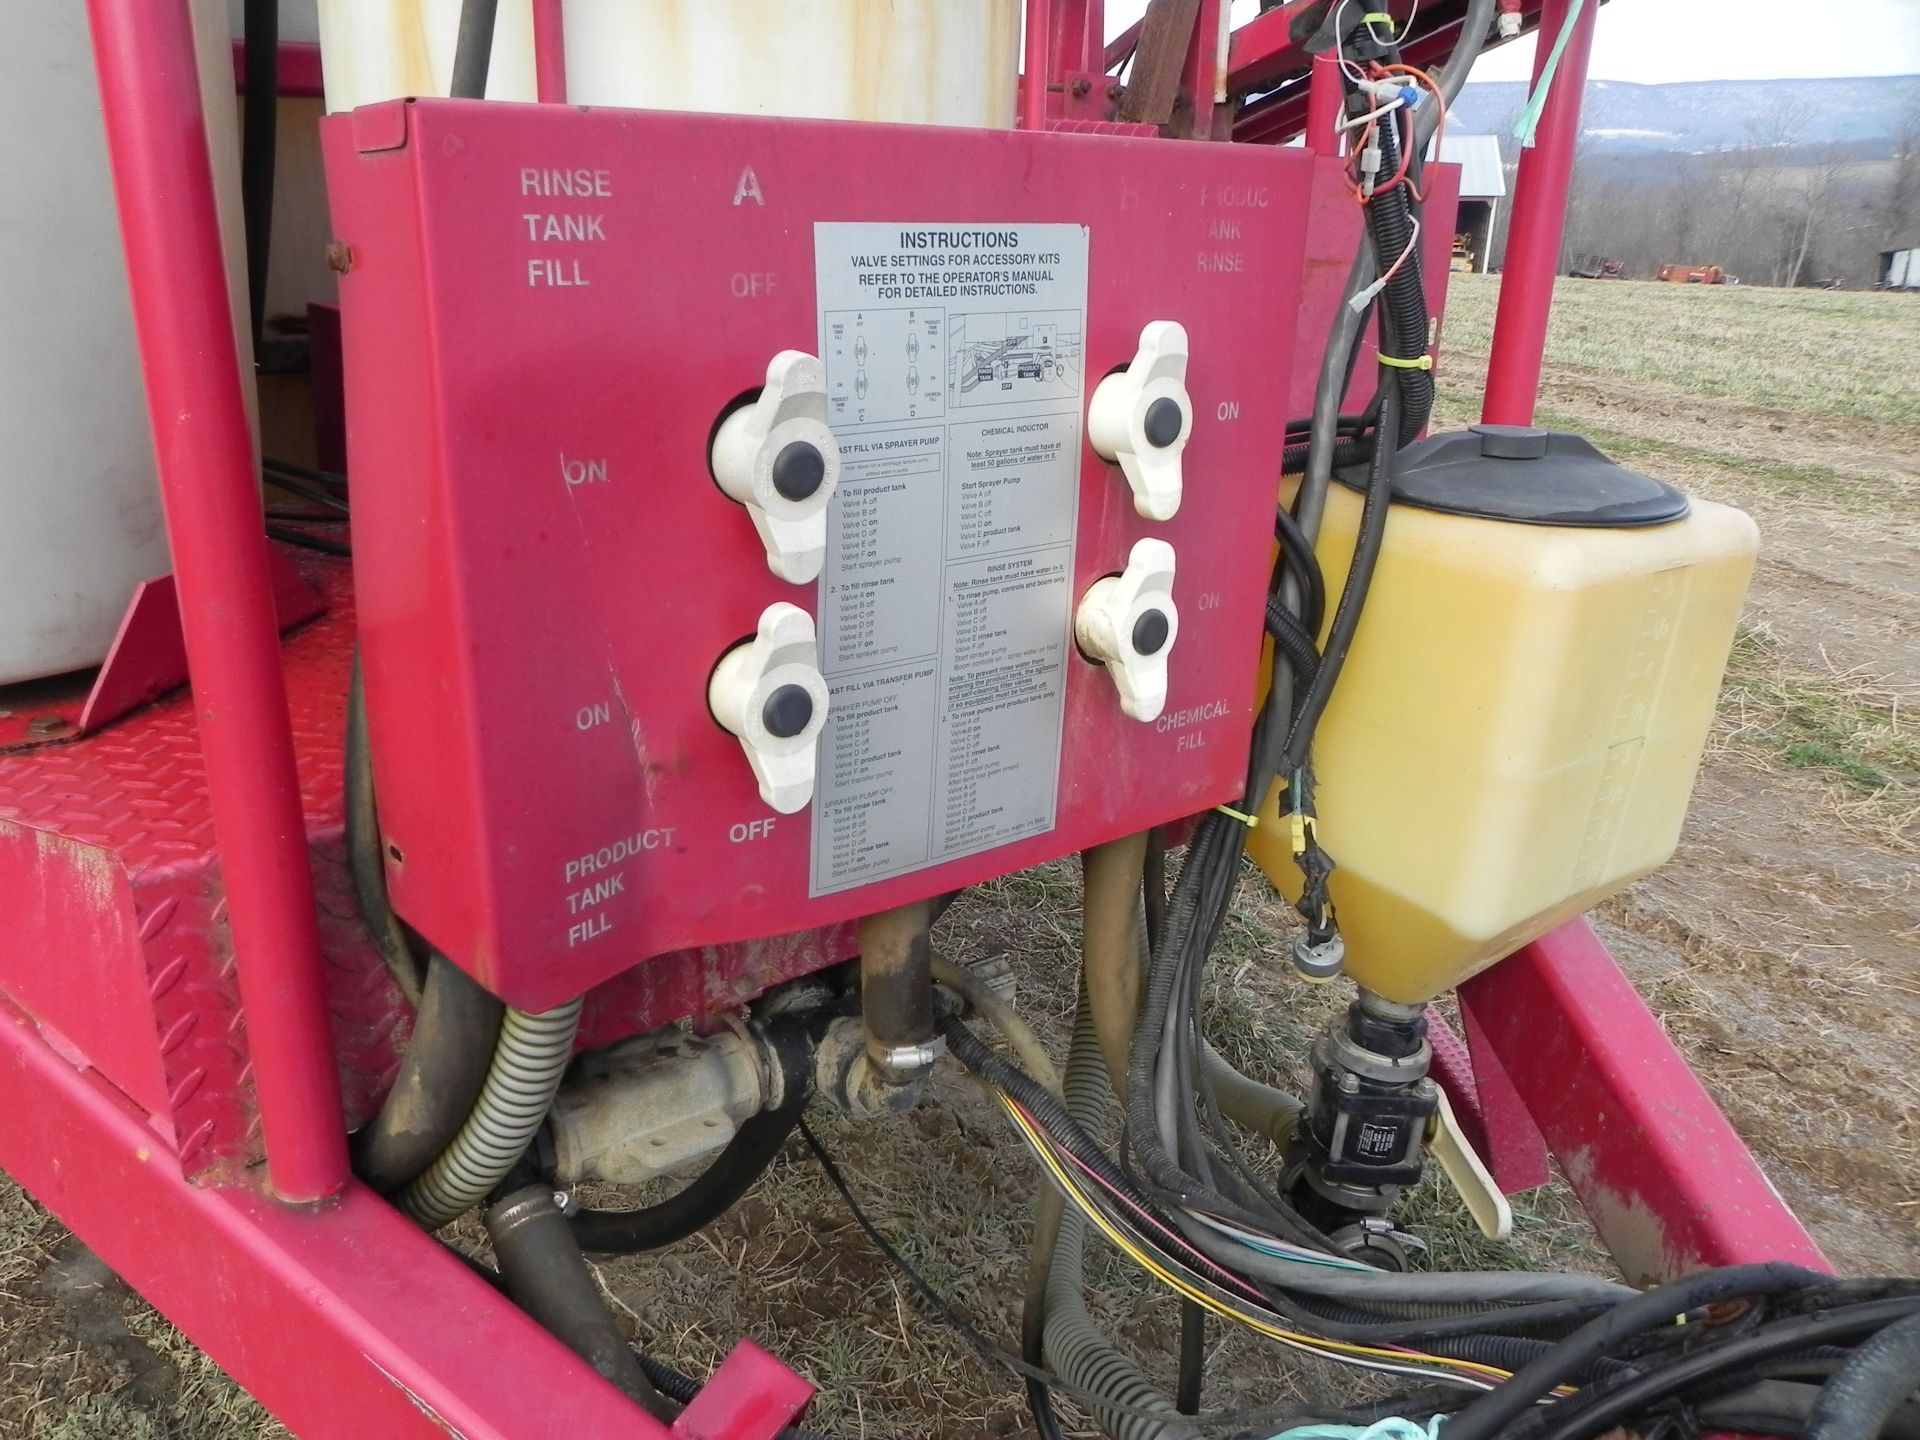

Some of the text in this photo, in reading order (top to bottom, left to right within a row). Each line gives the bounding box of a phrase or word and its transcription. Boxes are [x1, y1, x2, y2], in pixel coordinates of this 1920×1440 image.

[520, 167, 612, 197] RINSE
[732, 166, 765, 205] A
[523, 214, 607, 242] TANK
[900, 232, 1018, 248] INSTRUCTIONS
[851, 254, 1060, 267] VALVE SETTINGS FOR ACCESSORY KITS
[1197, 253, 1243, 272] RINSE
[528, 259, 590, 287] FILL
[859, 271, 1053, 285] REFER TO THE OPERATOR'S MANUAL
[730, 273, 777, 298] OFF
[878, 284, 1037, 299] FOR DETAILED INSTRUCTIONS.
[1217, 402, 1239, 421] ON
[982, 423, 1048, 436] CHEMICAL INDUCTOR
[839, 446, 852, 454] AST
[854, 444, 869, 452] FILL
[885, 439, 918, 449] SPRAYER
[920, 437, 939, 445] PUMP
[985, 449, 1008, 458] Sprayer
[996, 457, 1017, 467] gallons
[565, 459, 608, 485] ON
[864, 486, 890, 496] product
[962, 482, 976, 490] Start
[978, 480, 1001, 488] Sprayer
[988, 560, 1032, 573] RINSE SYSTEM
[990, 575, 1003, 583] tank
[1198, 592, 1219, 611] ON
[829, 687, 843, 695] AST
[846, 684, 861, 692] FILL
[876, 673, 913, 685] TRANSFER
[915, 669, 934, 678] PUMP
[862, 698, 882, 707] PUMP
[575, 702, 610, 730] ON
[857, 708, 882, 719] product
[1156, 699, 1230, 733] CHEMICAL
[1178, 731, 1206, 752] FILL
[729, 818, 776, 843] OFF
[565, 828, 676, 883] PRODUCT
[566, 872, 625, 914] TANK
[568, 913, 612, 947] FILL
